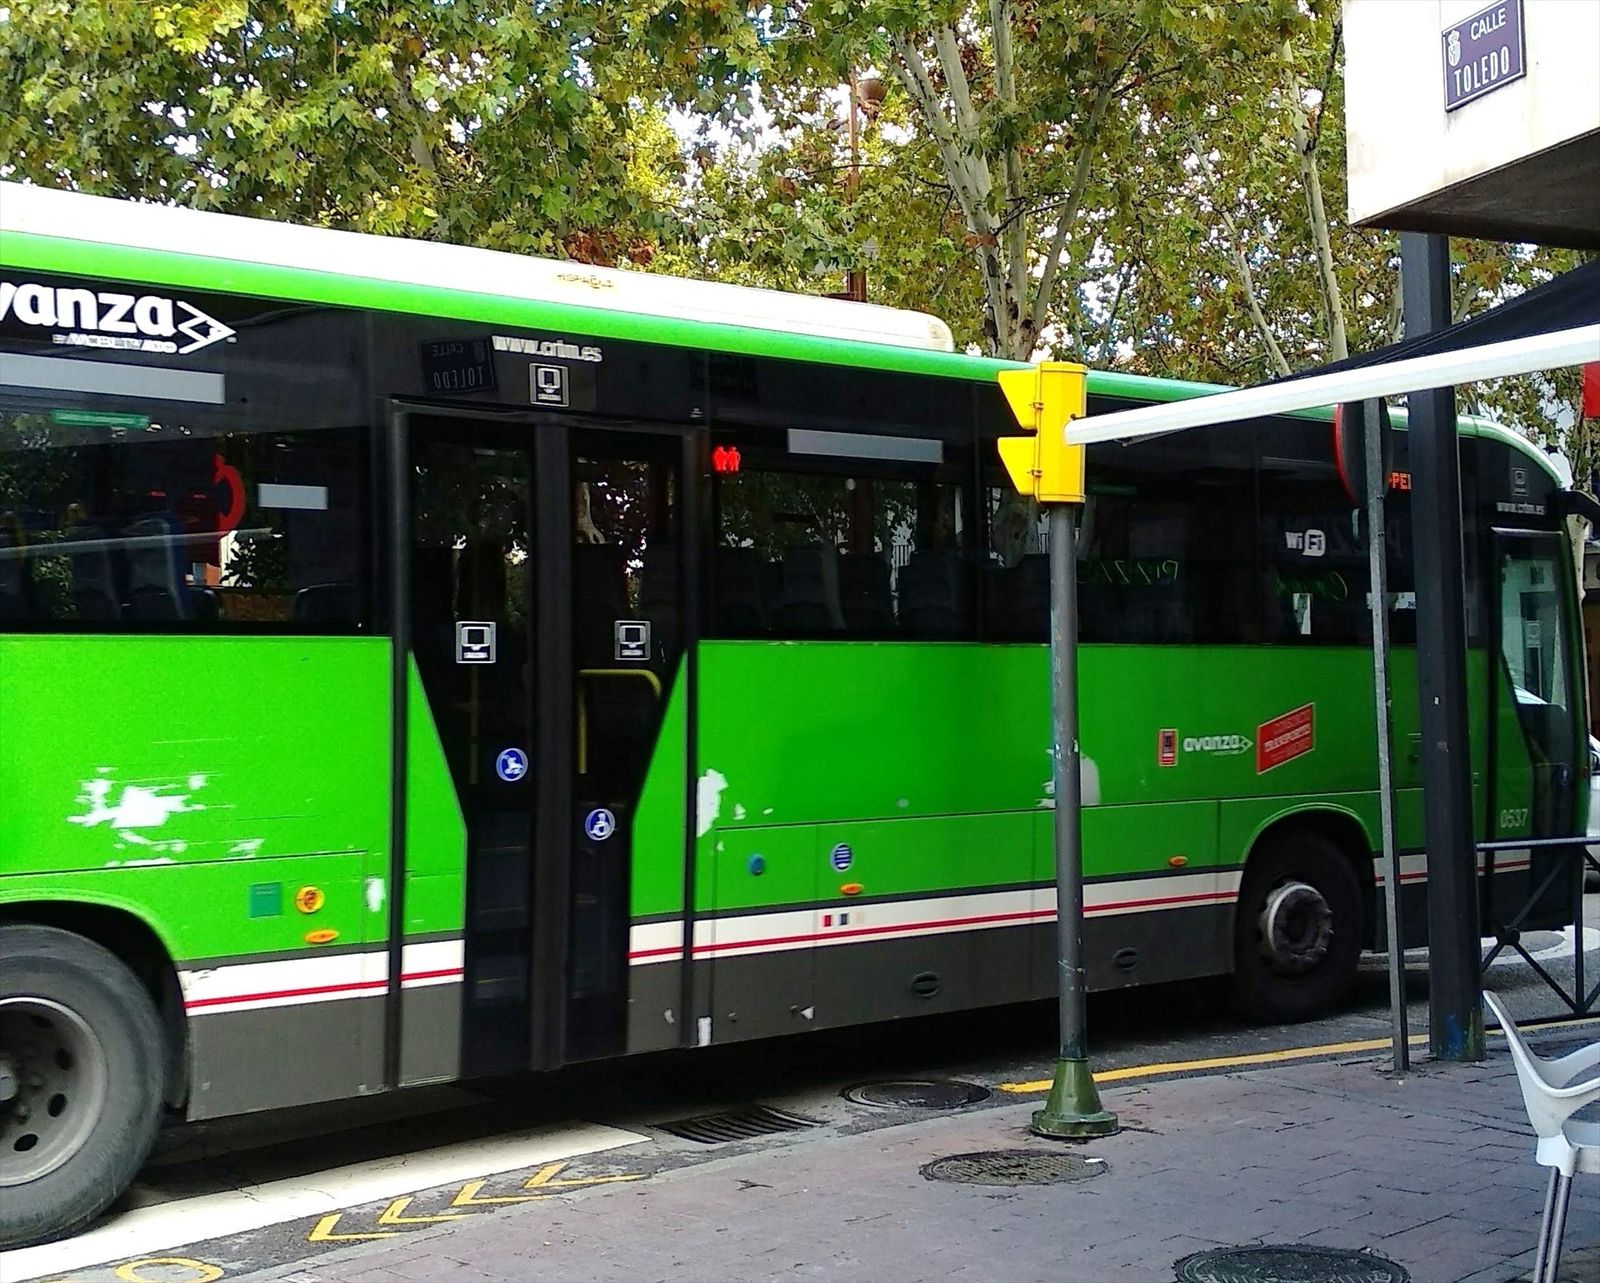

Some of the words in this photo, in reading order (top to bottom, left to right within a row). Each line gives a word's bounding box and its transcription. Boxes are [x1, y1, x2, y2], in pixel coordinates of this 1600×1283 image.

[1470, 7, 1507, 41] CALLE
[1453, 45, 1510, 97] TOLEDO
[1183, 734, 1241, 753] avanza
